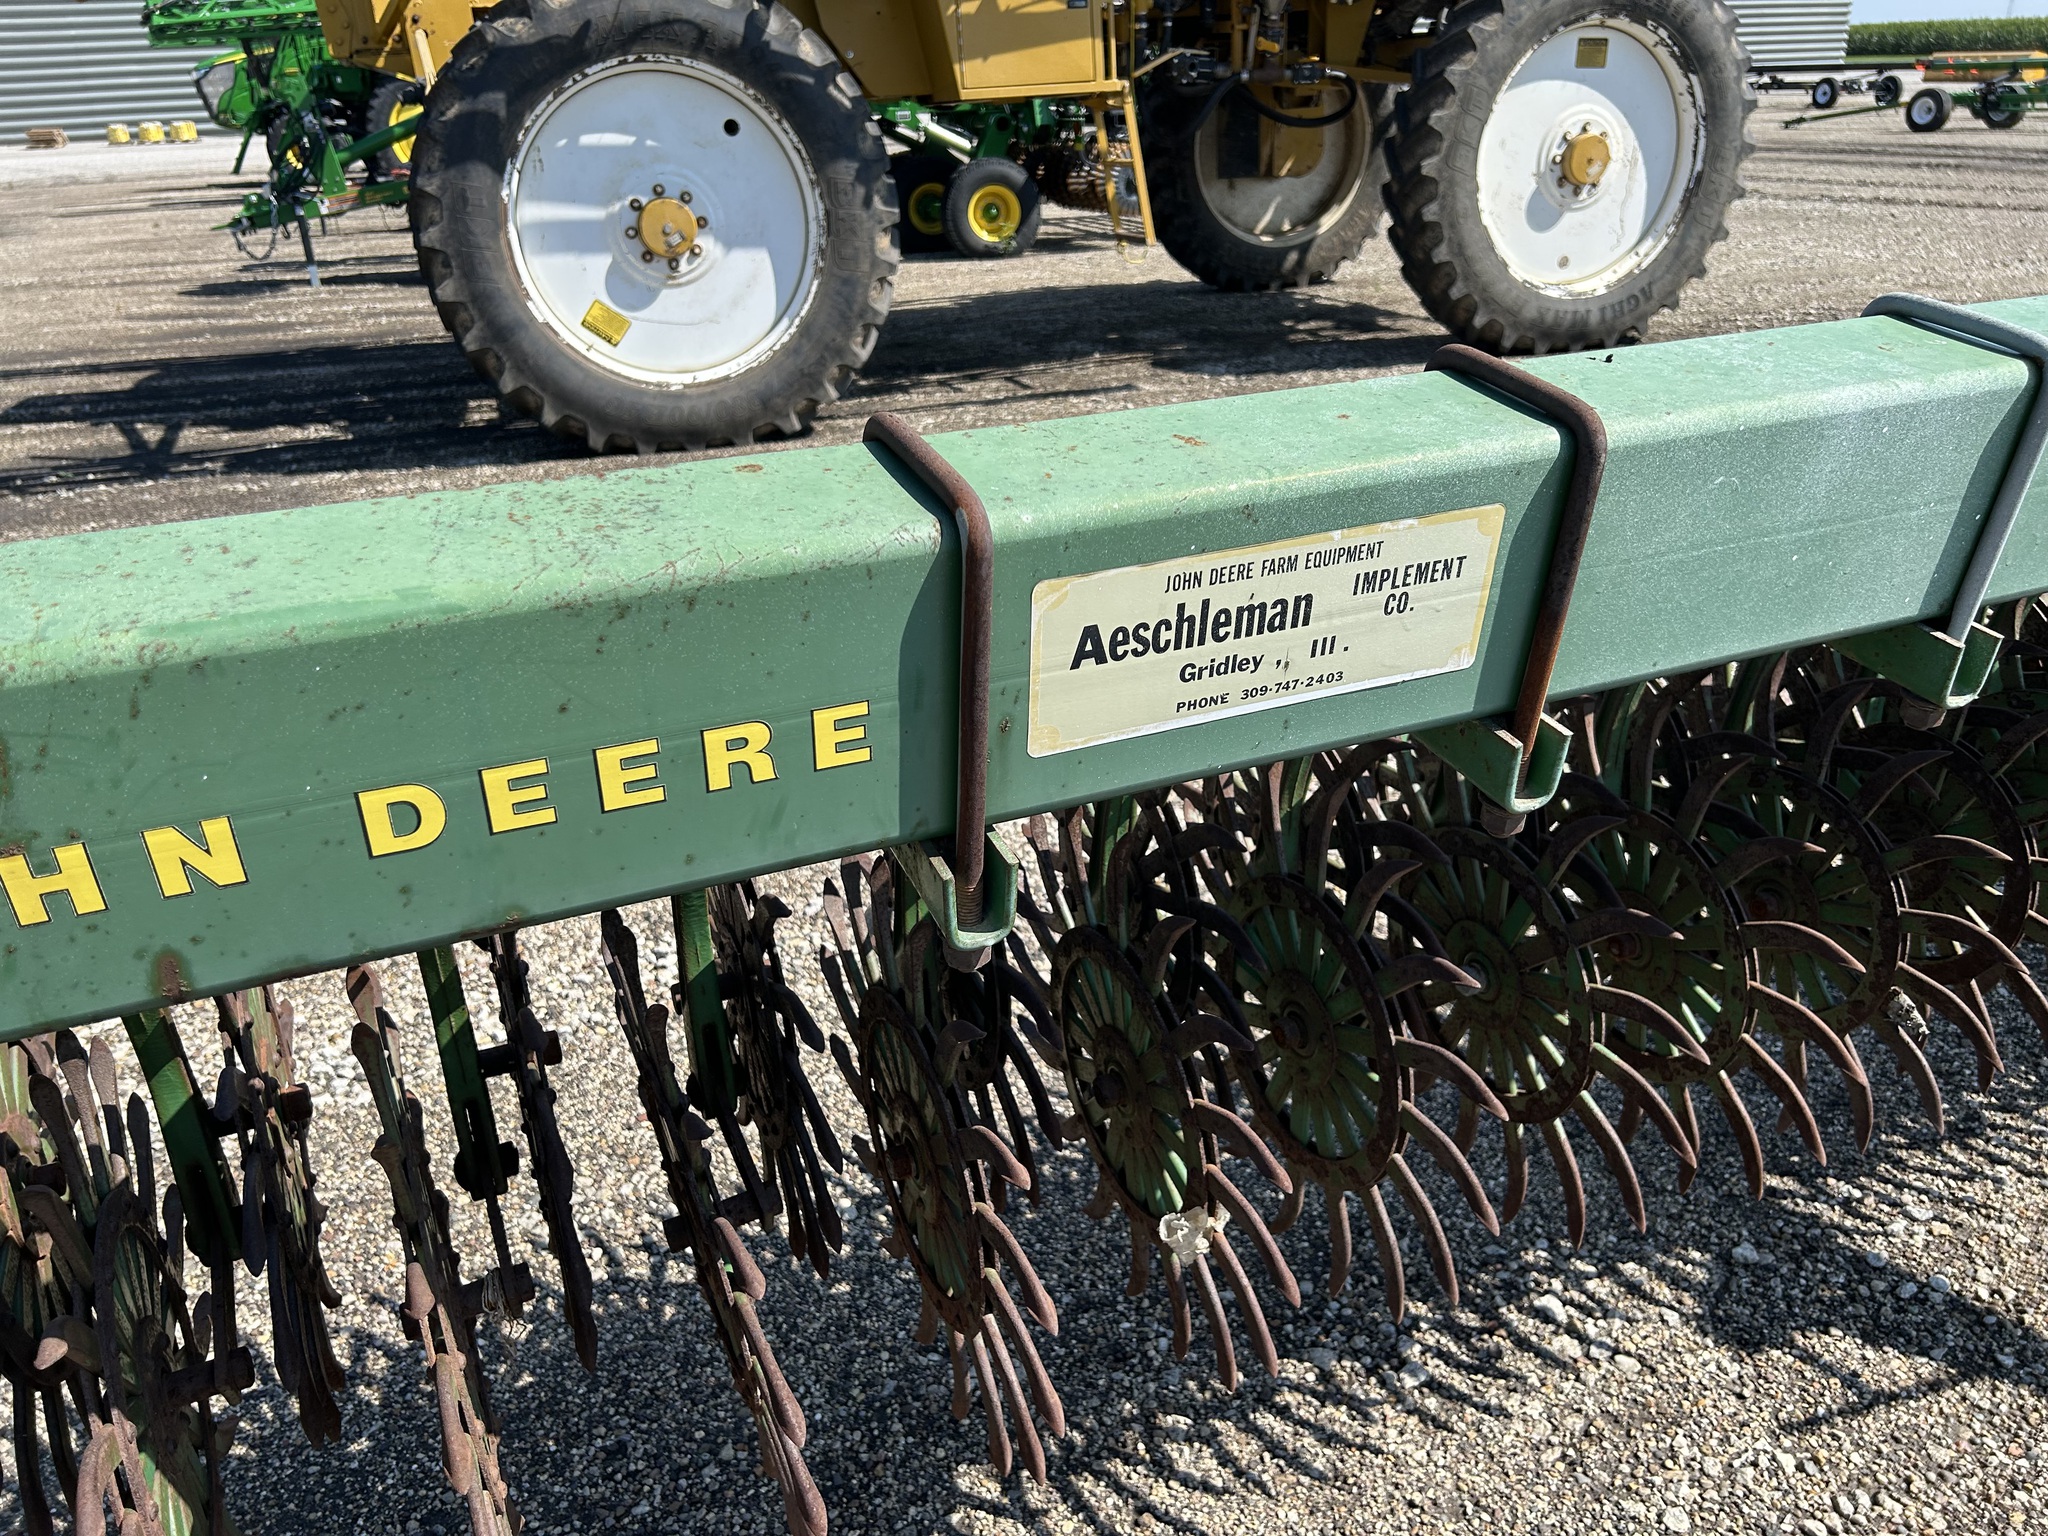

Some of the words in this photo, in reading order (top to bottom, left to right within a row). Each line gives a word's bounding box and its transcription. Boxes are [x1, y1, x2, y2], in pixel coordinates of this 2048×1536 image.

[1165, 567, 1202, 594] JOHN
[1209, 561, 1254, 586] DEERE
[1260, 554, 1298, 578] FARM
[1304, 540, 1385, 573] EQUIPMENT
[1352, 555, 1468, 596] IMPLEMENT
[1383, 592, 1415, 616] CO.
[1069, 592, 1314, 671] Aeschleman
[1176, 692, 1230, 713] PHONE
[357, 700, 872, 858] DEERE
